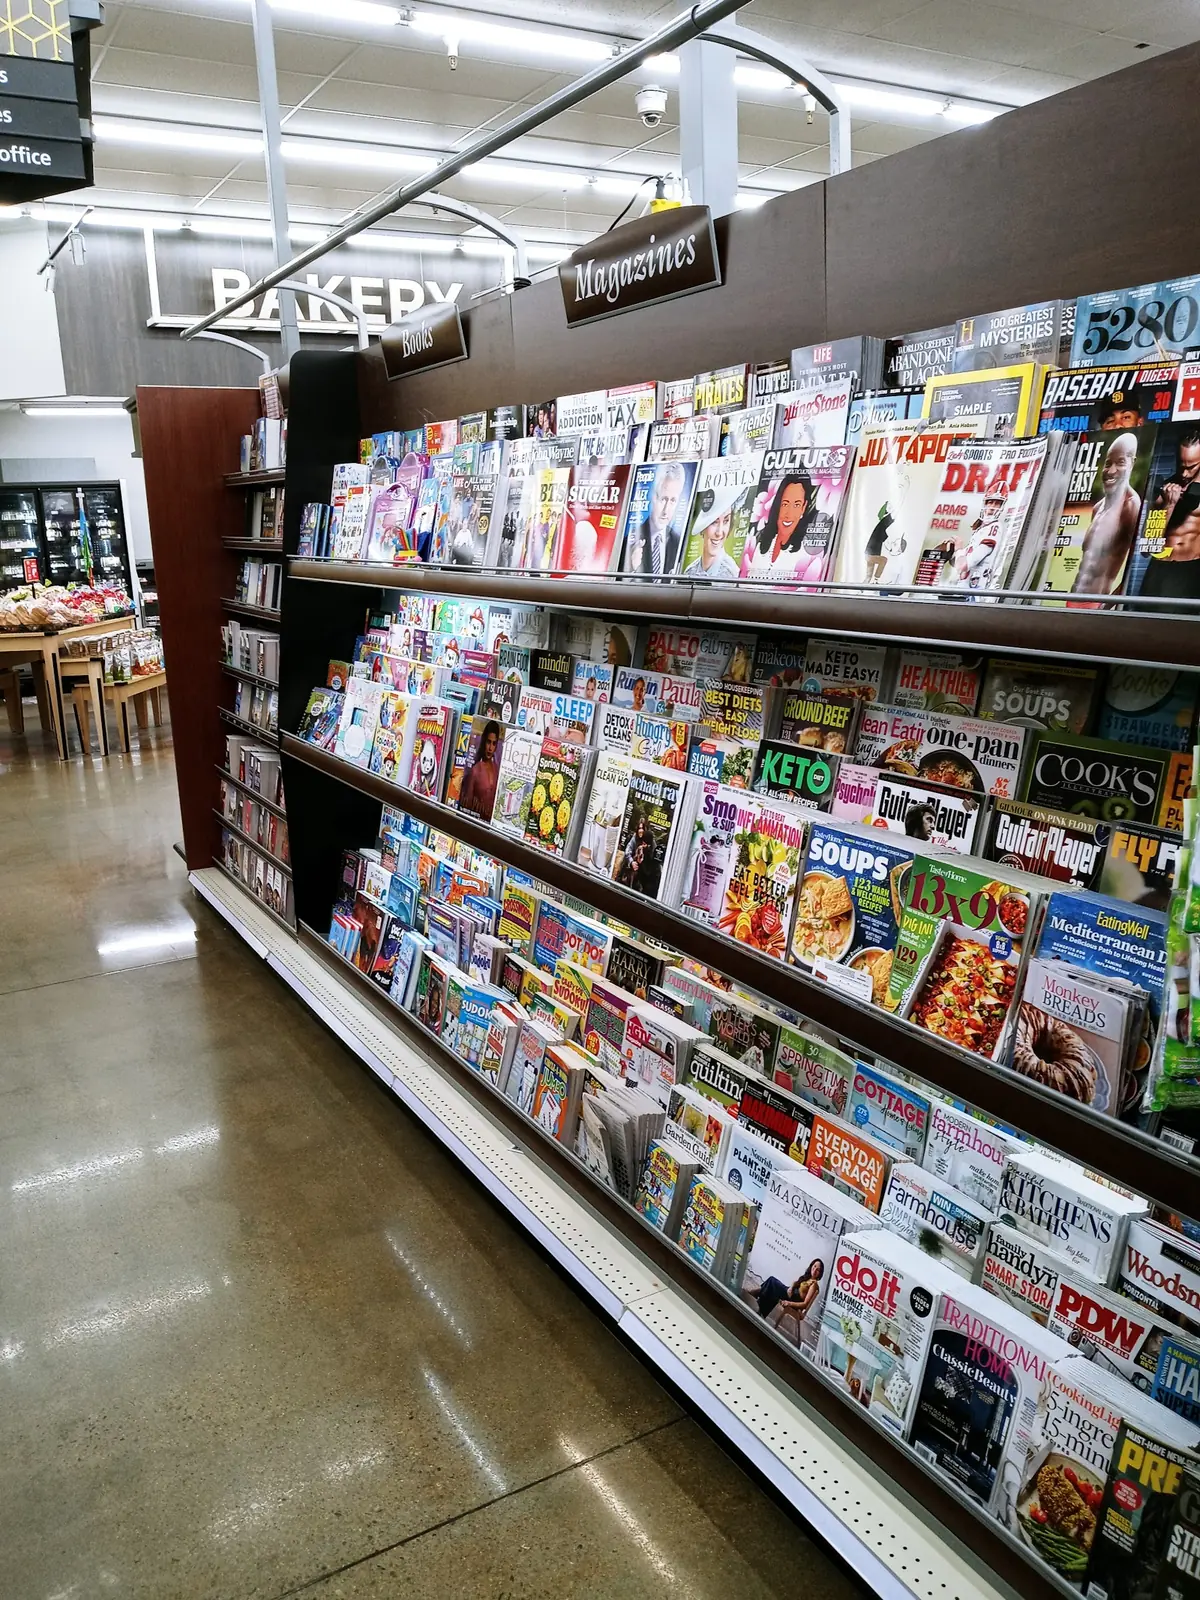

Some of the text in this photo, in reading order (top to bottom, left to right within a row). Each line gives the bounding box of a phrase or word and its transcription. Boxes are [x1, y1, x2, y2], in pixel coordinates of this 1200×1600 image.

[0, 145, 51, 166] office
[574, 234, 696, 303] Magazines
[211, 268, 464, 323] BAKERY
[990, 308, 1055, 328] 100 GREATEST
[1083, 295, 1199, 355] 5280
[402, 327, 433, 359] Books
[980, 321, 1053, 348] MYSTERIES
[814, 347, 832, 363] LIFE
[832, 363, 847, 371] MOST
[1139, 368, 1176, 382] DIGEST
[694, 376, 744, 411] PIRATES
[608, 402, 637, 429] TAX
[954, 402, 992, 415] SIMPLE
[558, 413, 603, 429] ADDICTION
[1039, 416, 1089, 433] SEASON
[964, 449, 993, 461] SPORTS
[635, 471, 655, 485] People
[705, 467, 757, 488] ROYALS
[1069, 471, 1098, 493] EASY
[569, 486, 620, 503] SUGAR
[934, 505, 968, 516] ARMS
[1148, 510, 1167, 519] LOSE
[931, 519, 960, 530] RACE
[1145, 528, 1163, 538] GUT!
[1146, 520, 1166, 529] YOUR
[648, 631, 699, 658] PALEO
[538, 654, 571, 674] mindful
[825, 650, 859, 664] KETO
[544, 677, 562, 689] Freedom
[755, 669, 763, 678] 67
[805, 661, 880, 683] MADE EASY!
[900, 665, 977, 698] HEALTHIER
[598, 681, 611, 691] 2021
[659, 676, 701, 708] Paula
[724, 683, 763, 697] HOUSEKEEPING
[521, 695, 540, 710] HAPPY
[554, 697, 593, 722] SLEEP
[705, 690, 762, 713] BEST DIETS
[992, 690, 1071, 722] SOUPS
[554, 717, 574, 728] BETTER
[606, 713, 629, 728] DETOX
[725, 710, 748, 723] EASY
[783, 699, 851, 728] GROUND BEEF
[634, 713, 672, 747] Hungry
[502, 740, 538, 769] Herb
[926, 726, 1020, 768] one-pan
[539, 757, 578, 781] Spring treats
[690, 765, 708, 775] EASY
[691, 753, 708, 766] SLOW
[978, 753, 1016, 771] dinners
[596, 768, 615, 784] CLEAN
[762, 750, 832, 795] KETO
[1035, 753, 1157, 806] COOK'S
[641, 795, 664, 807] SEASON
[768, 790, 818, 810] ALL-NEW RECIPES
[760, 808, 769, 816] EAT
[999, 802, 1094, 833] GILMOUR ON PINK FLOYD
[737, 808, 800, 848] INFLAMMATION
[809, 838, 889, 880] SOUPS
[1111, 832, 1159, 872] FLY
[734, 865, 751, 878] EAT
[729, 878, 750, 899] FEEL
[854, 877, 889, 897] 123 WARM
[856, 890, 890, 907] WELCOMING
[858, 900, 883, 913] RECIPES
[908, 872, 999, 932] 13x9
[903, 916, 919, 931] DIG
[1050, 916, 1156, 961] Mediterranean
[584, 943, 604, 960] DOT
[612, 949, 651, 976] HARRY
[896, 944, 918, 964] 129
[1069, 936, 1097, 950] Delicious
[1097, 944, 1112, 955] Path
[1113, 949, 1120, 958] to
[1121, 952, 1147, 967] Lifelong
[553, 978, 589, 1014] SUDOKU!
[1041, 974, 1100, 1013] Monkey
[1042, 988, 1106, 1028] BREADS
[490, 1025, 504, 1043] EASY
[626, 1022, 651, 1044] HGTV
[716, 1020, 751, 1046] WORLD
[807, 1045, 818, 1056] 30
[781, 1046, 849, 1091] SPRINGTIME
[541, 1068, 567, 1099] JUMBO
[802, 1071, 846, 1114] Sewing
[853, 1074, 925, 1129] COTTAGE
[944, 1113, 971, 1133] MODERN
[665, 1123, 691, 1148] Garden
[692, 1144, 715, 1170] Guide
[795, 1122, 811, 1150] PC
[934, 1129, 969, 1155] style
[750, 1148, 773, 1168] Nourish
[815, 1124, 883, 1176] EVERYDAY
[749, 1170, 767, 1187] LIVING
[815, 1142, 879, 1195] STORAGE
[933, 1193, 951, 1212] WIN
[1002, 1171, 1112, 1244] KITCHENS
[1000, 1190, 1070, 1242] & BATHS
[996, 1234, 1027, 1259] family
[836, 1253, 902, 1309] do it
[984, 1257, 1017, 1288] SMART
[832, 1288, 864, 1312] MAXIMIZE
[835, 1274, 897, 1319] YOURSELF
[912, 1293, 930, 1310] UNDER
[1122, 1281, 1160, 1311] HORIZONTAL
[847, 1303, 863, 1319] SPACES
[1055, 1282, 1145, 1354] PDW
[964, 1337, 1015, 1385] HOME
[1126, 1429, 1167, 1457] MUST-HAVE
